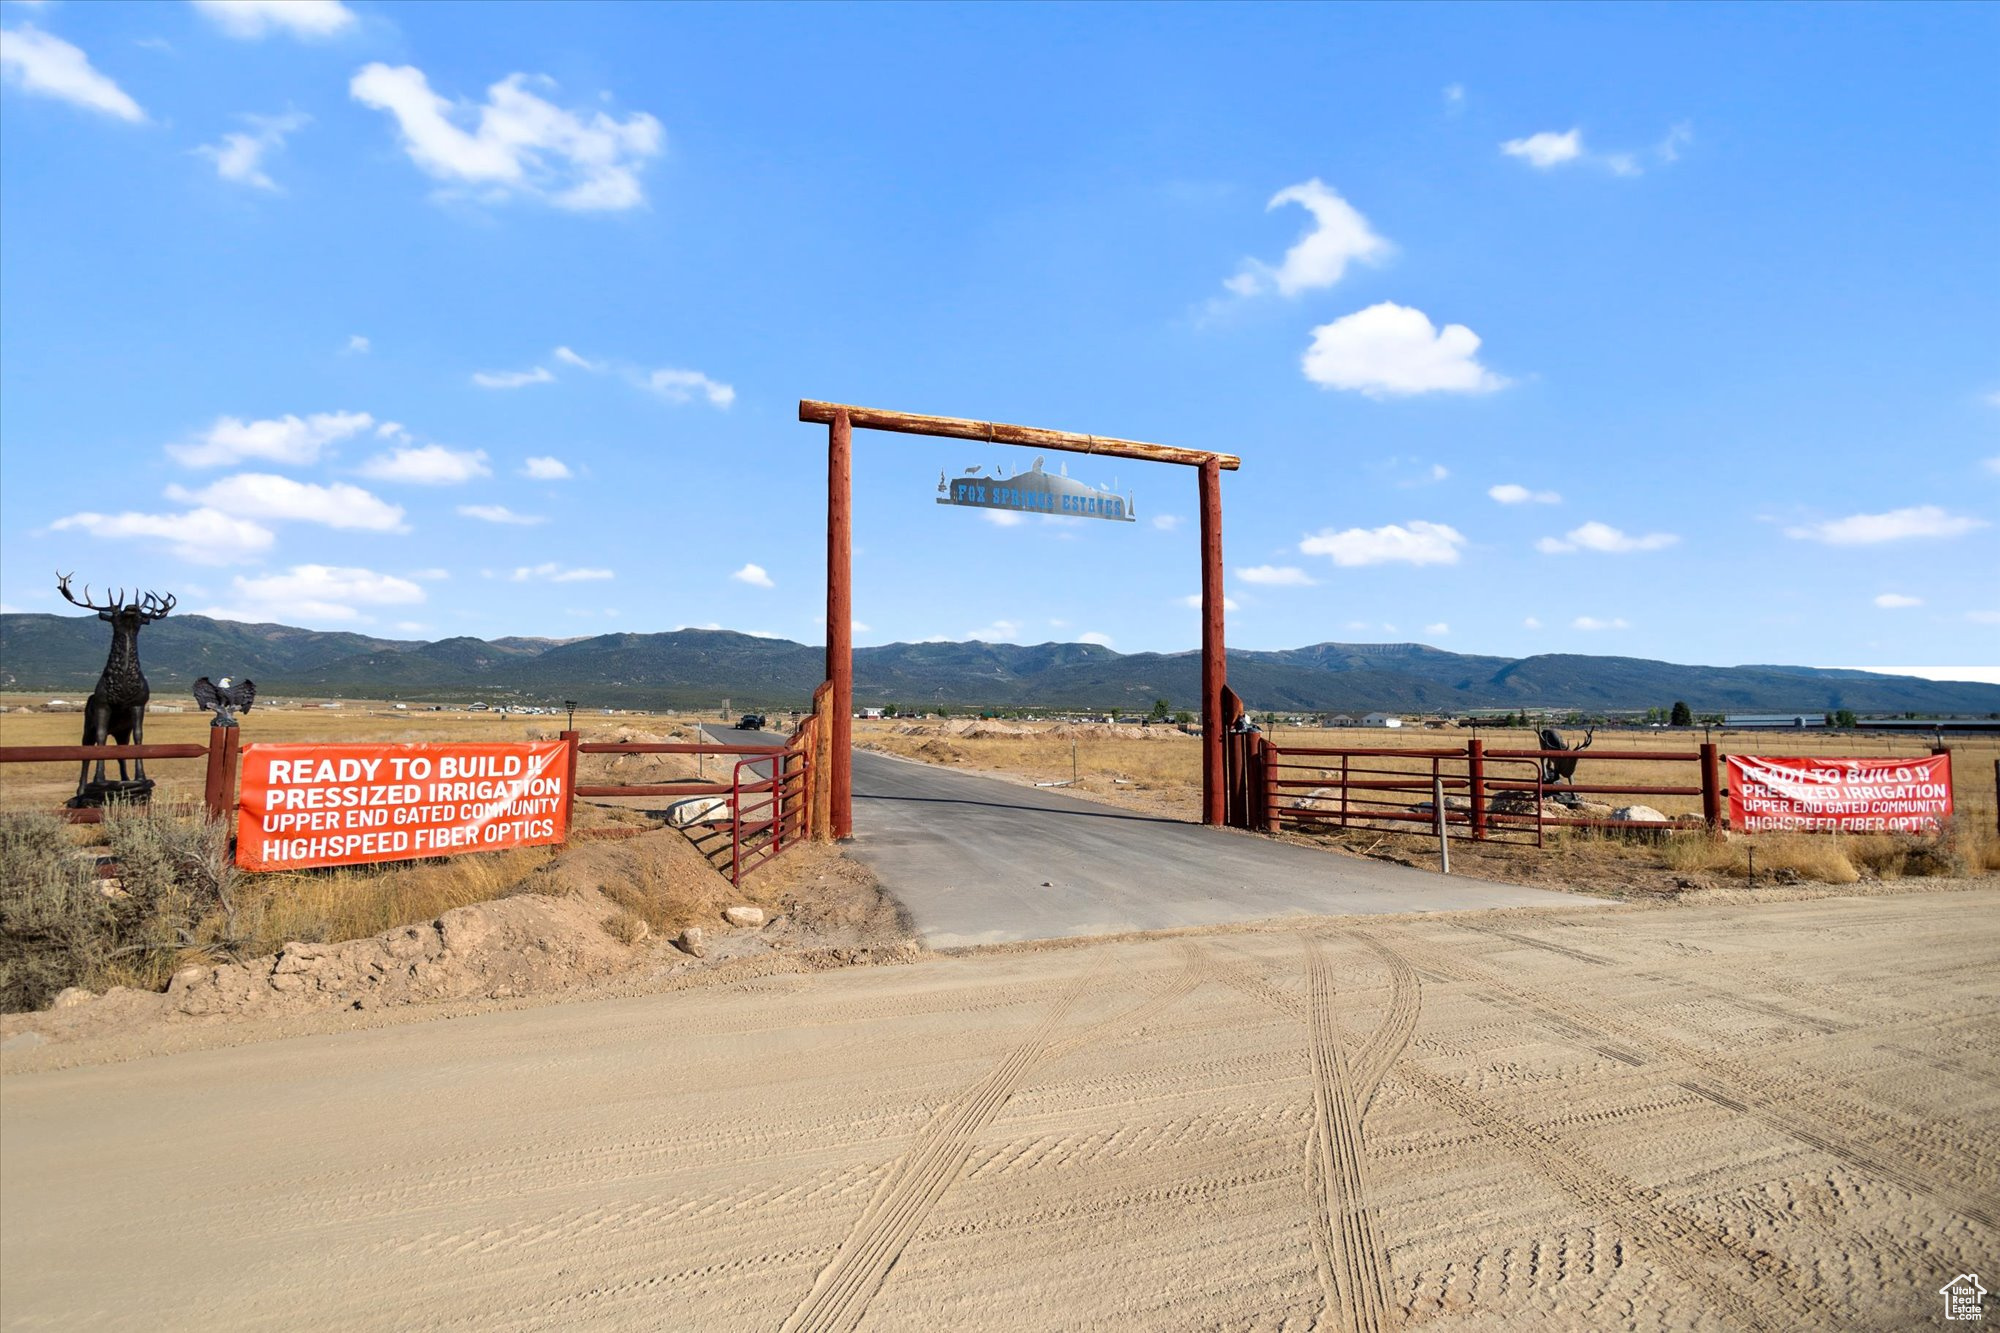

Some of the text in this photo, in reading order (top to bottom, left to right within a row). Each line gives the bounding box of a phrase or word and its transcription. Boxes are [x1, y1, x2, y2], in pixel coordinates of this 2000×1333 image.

[958, 484, 1121, 516] FOX SPRINGS ESTATES
[268, 755, 542, 785] READY TO BUILD !!
[1742, 766, 1930, 784] READY TO BUILD !!
[265, 777, 561, 811] PRESSIZED IRRIGATION
[1742, 783, 1946, 800] PRESSIZED IRRIGATION
[262, 797, 560, 833] UPPER END GATED COMMUNITY
[1743, 799, 1947, 815] UPPER END GATED COMMUNITY
[1744, 815, 1837, 831] HIGHSPEED
[1840, 817, 1885, 831] FIBER
[262, 819, 554, 862] HIGHSPEED FIBER OPTICS
